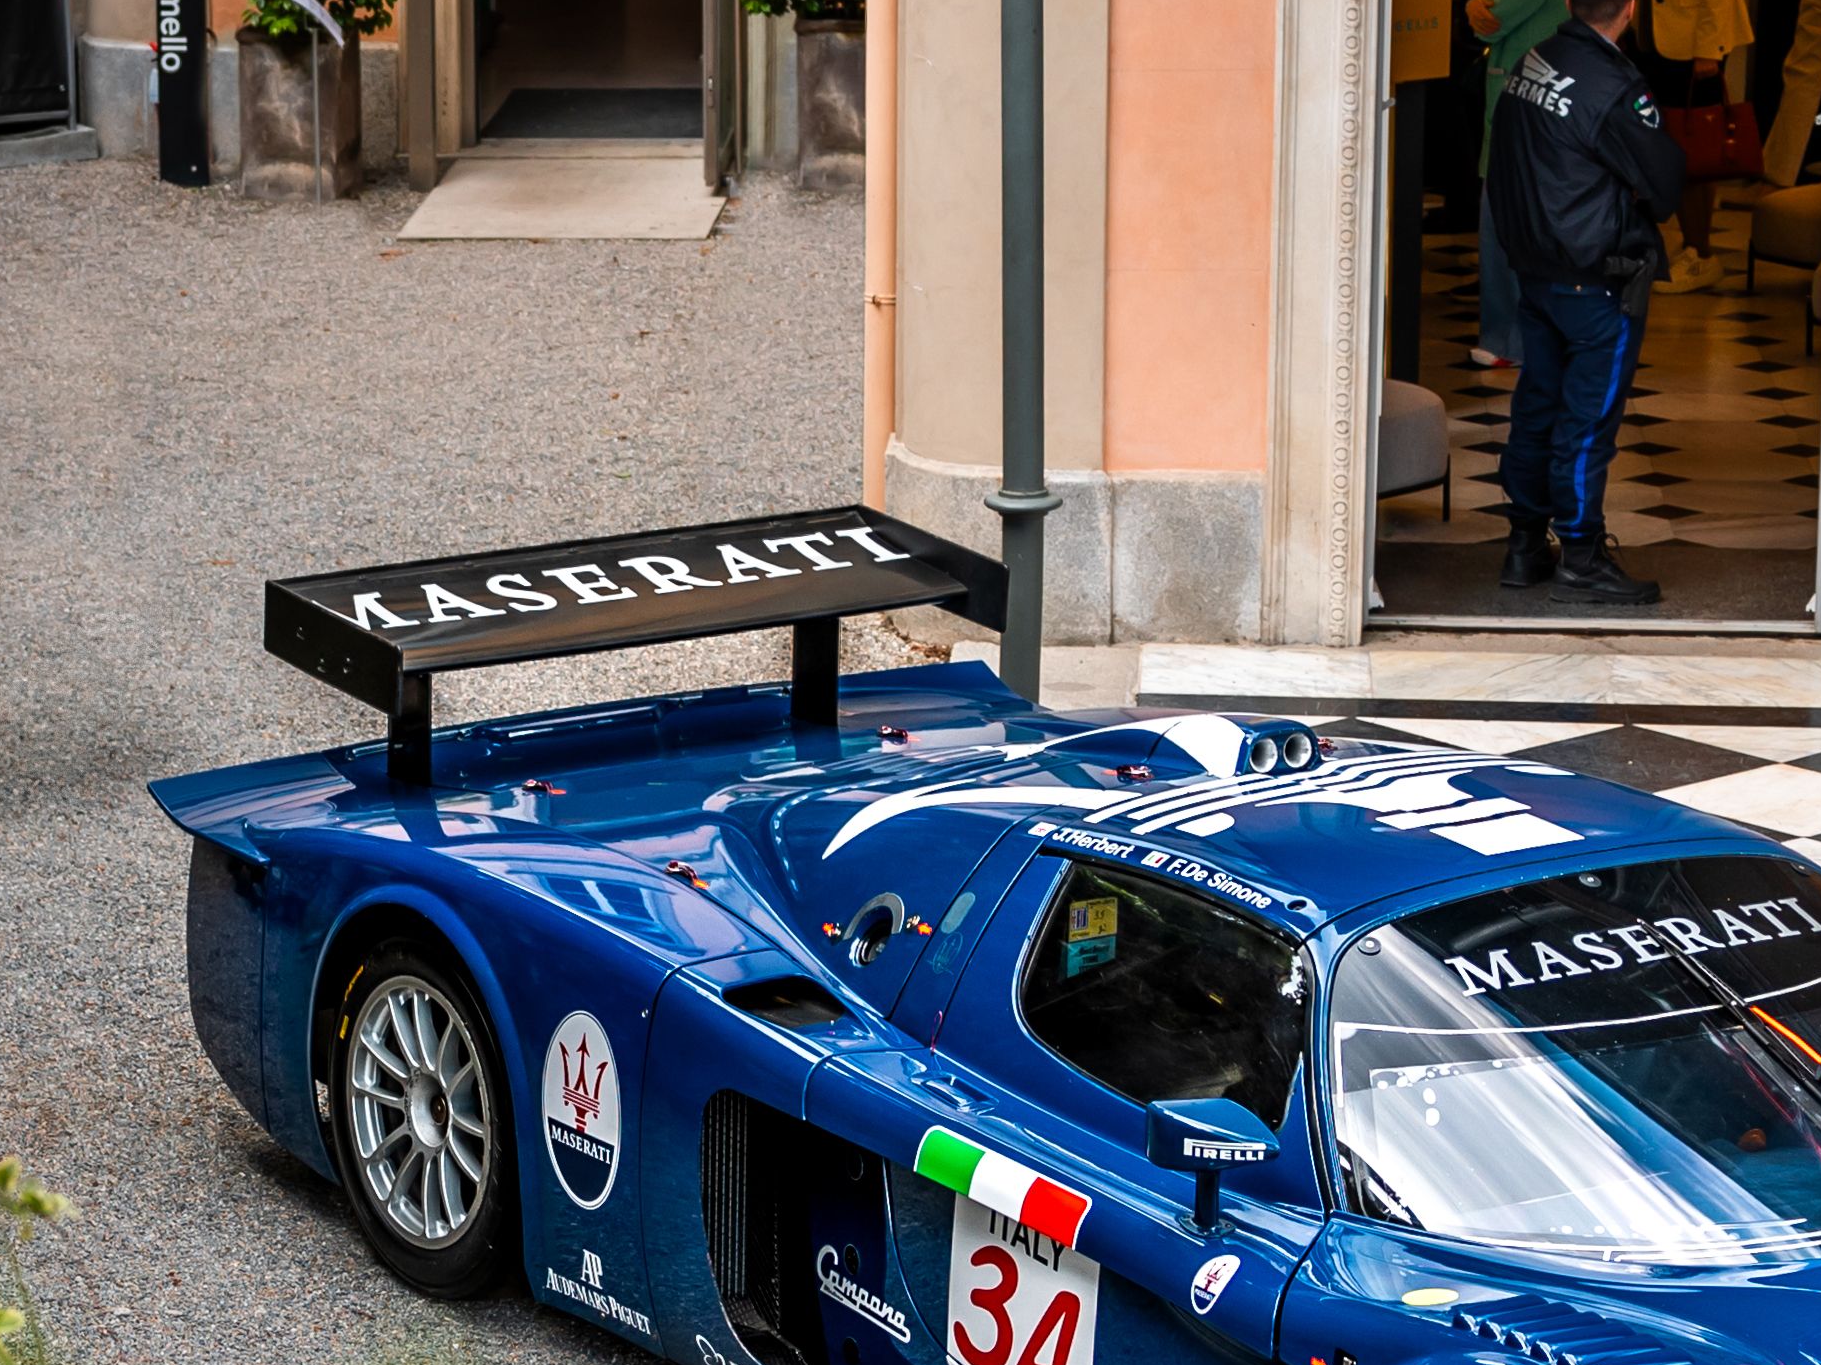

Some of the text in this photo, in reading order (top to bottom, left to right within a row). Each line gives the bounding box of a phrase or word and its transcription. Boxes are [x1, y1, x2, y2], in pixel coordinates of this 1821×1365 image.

[312, 527, 910, 631] MASERATI
[1052, 828, 1134, 859] J.Herbert
[1207, 873, 1272, 910] Simone
[551, 1124, 611, 1164] MASERATI
[1183, 1137, 1267, 1161] PIRELLI
[546, 1266, 651, 1335] AUDEMARS PIGUET
